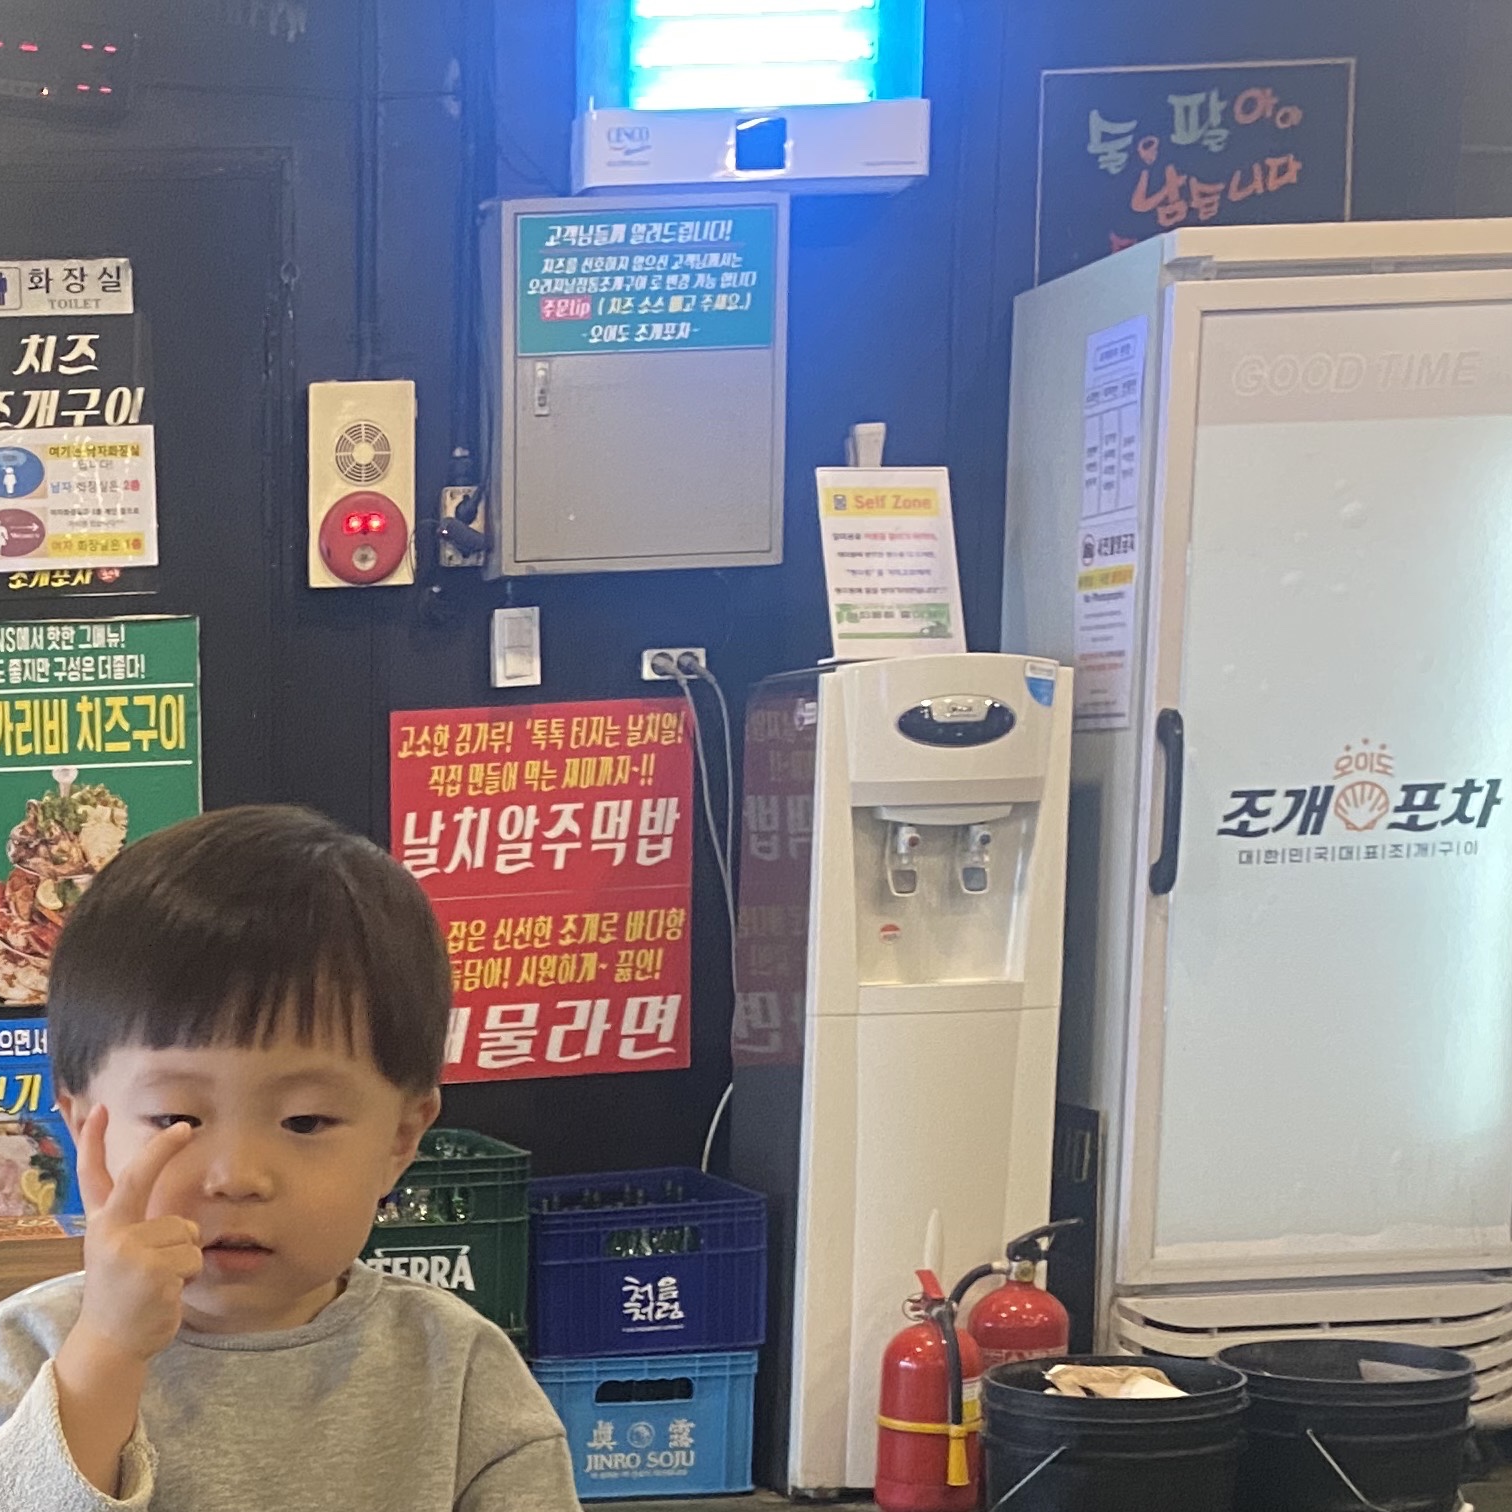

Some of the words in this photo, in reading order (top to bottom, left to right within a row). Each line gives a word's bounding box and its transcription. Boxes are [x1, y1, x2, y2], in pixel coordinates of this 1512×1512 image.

[1131, 153, 1302, 227] 남습니다
[545, 224, 627, 247] 고객님들께
[630, 219, 733, 244] 알려드립니다!
[27, 265, 123, 295] 화장실
[541, 257, 578, 274] 치즈를
[581, 256, 630, 273] 선호하지
[49, 298, 102, 310] TOILET
[12, 333, 100, 376] 치즈
[1233, 352, 1367, 395] GOOD
[1377, 350, 1481, 392] TIME
[854, 494, 887, 510] Self
[892, 494, 933, 510] Zone
[47, 626, 76, 651] 핫한
[8, 657, 49, 684] 좋지만
[53, 656, 96, 683] 구성은
[76, 694, 186, 753] 치즈구이
[398, 724, 450, 759] 고소한
[455, 720, 514, 757] 김가루!
[570, 715, 622, 750] 터지는
[627, 711, 685, 748] 날치알!
[467, 761, 519, 796] 만들어
[524, 759, 557, 793] 먹는
[1333, 751, 1396, 780] 오이도
[1216, 784, 1336, 838] 조개
[1386, 777, 1503, 832] 포차
[402, 797, 681, 880] 날치알주먹밥
[446, 919, 486, 955] 잡은
[492, 915, 553, 952] 신선한
[558, 911, 620, 947] 조개로
[624, 907, 686, 942] 바다향
[366, 1253, 476, 1292] TERRA
[583, 1452, 642, 1473] JINRO
[646, 1450, 695, 1470] SOJU
